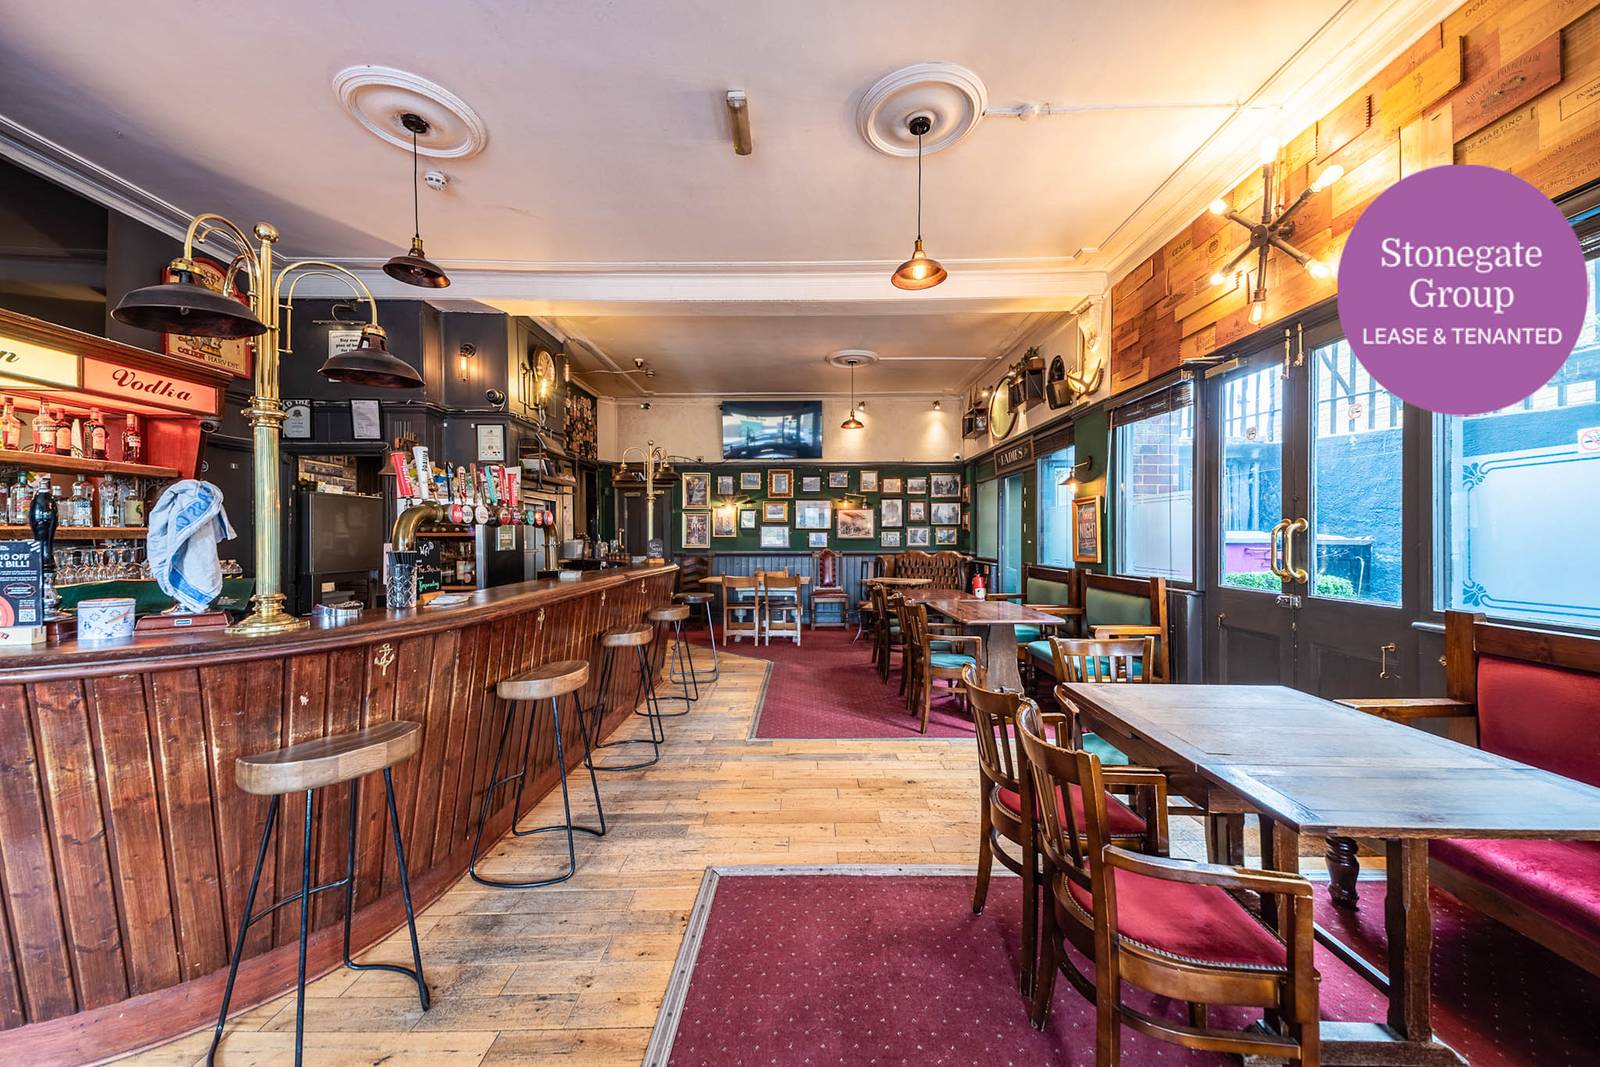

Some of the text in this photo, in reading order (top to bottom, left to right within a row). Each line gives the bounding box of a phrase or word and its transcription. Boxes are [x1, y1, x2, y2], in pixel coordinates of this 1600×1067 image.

[112, 368, 192, 402] Vodka
[1000, 449, 1023, 466] LADIES
[11, 553, 30, 561] OFF
[5, 560, 30, 568] BILL!
